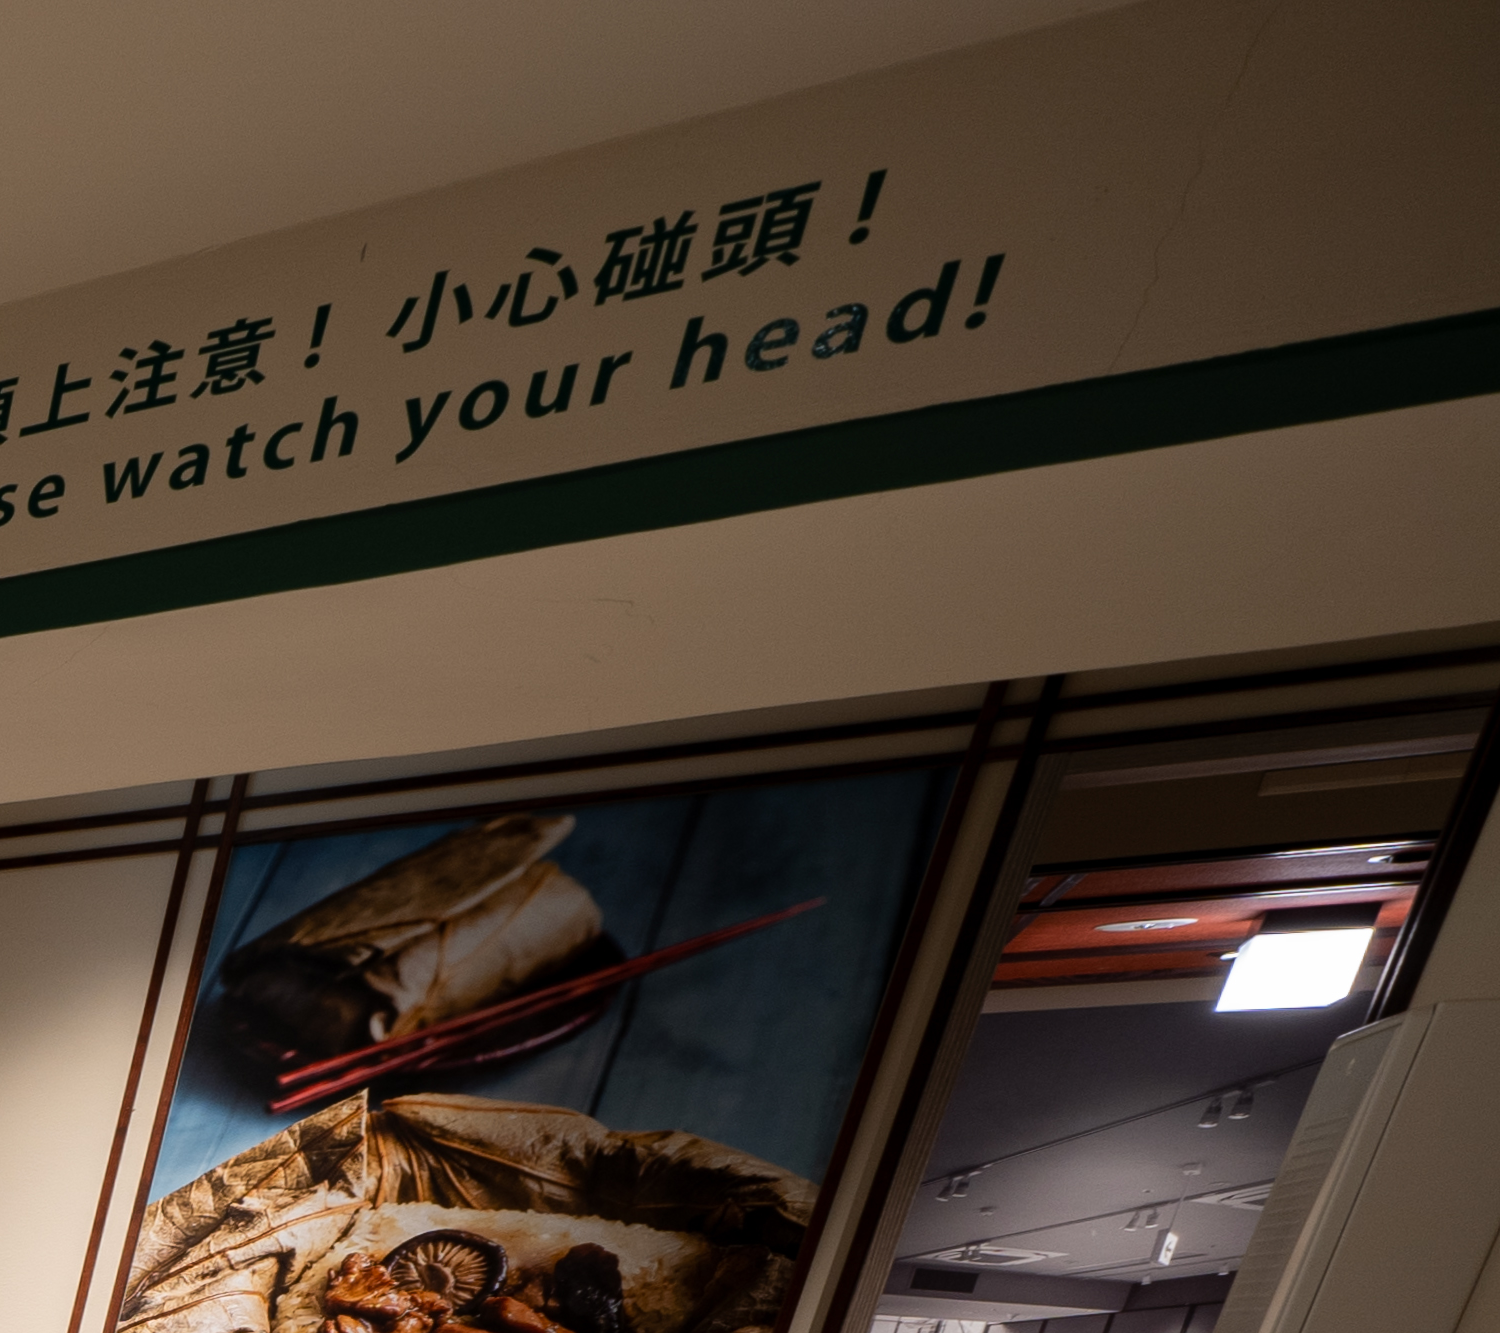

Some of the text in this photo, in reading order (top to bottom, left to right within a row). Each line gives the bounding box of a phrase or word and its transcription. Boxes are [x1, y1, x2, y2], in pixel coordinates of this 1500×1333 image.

[103, 395, 359, 504] watch
[395, 350, 633, 465] your
[669, 253, 1006, 390] head!
